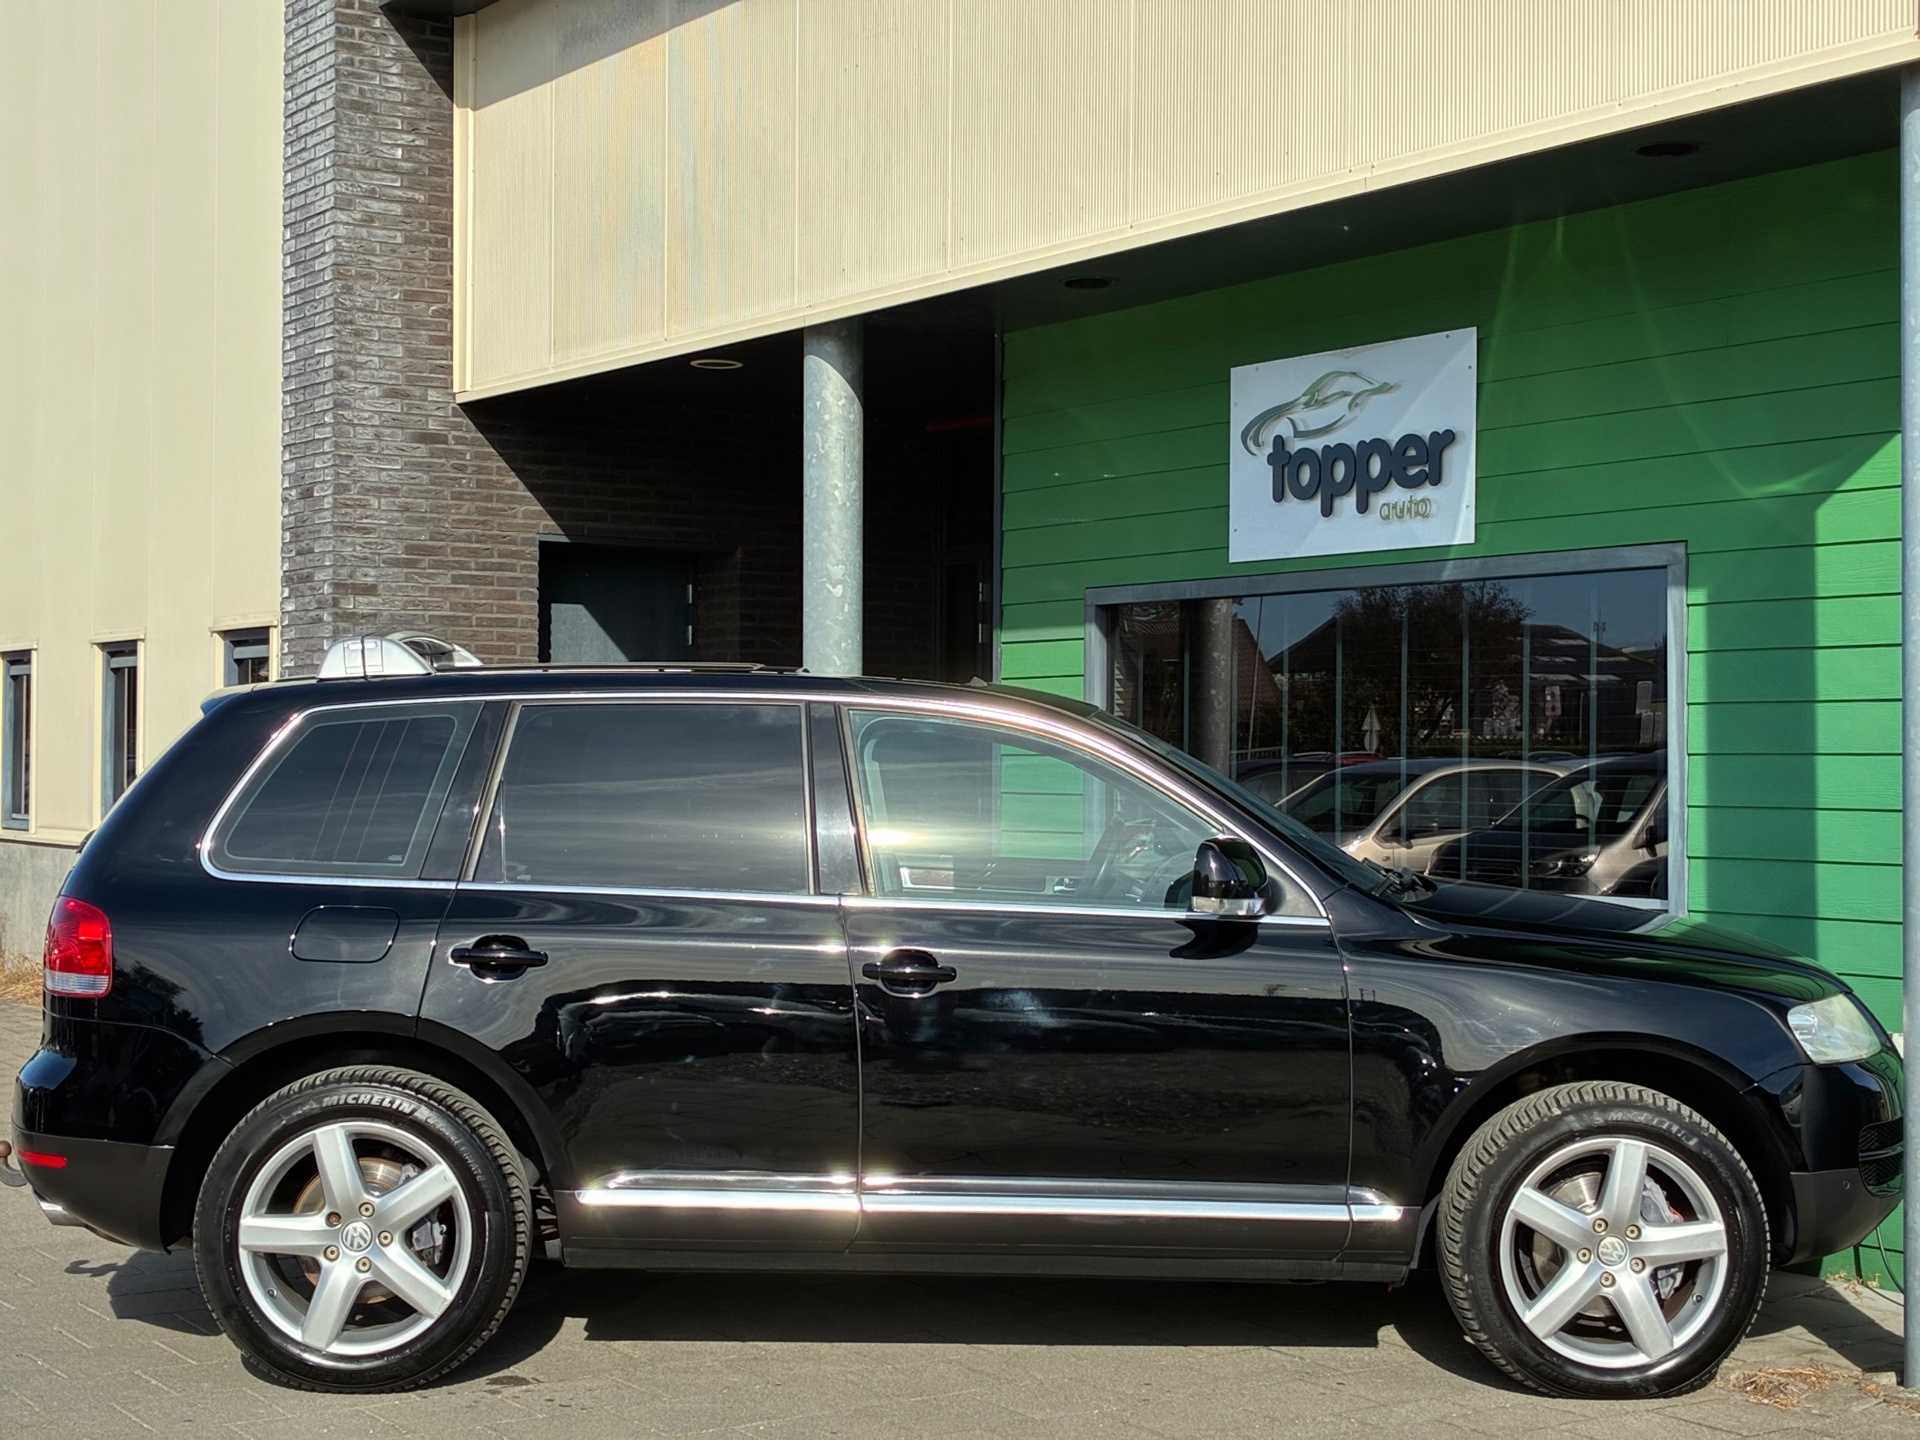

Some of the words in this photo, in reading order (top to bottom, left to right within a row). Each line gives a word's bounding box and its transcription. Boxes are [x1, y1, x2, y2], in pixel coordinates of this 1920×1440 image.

[1267, 429, 1456, 518] topper
[1379, 495, 1432, 521] auto
[322, 1093, 416, 1115] MICHELIN
